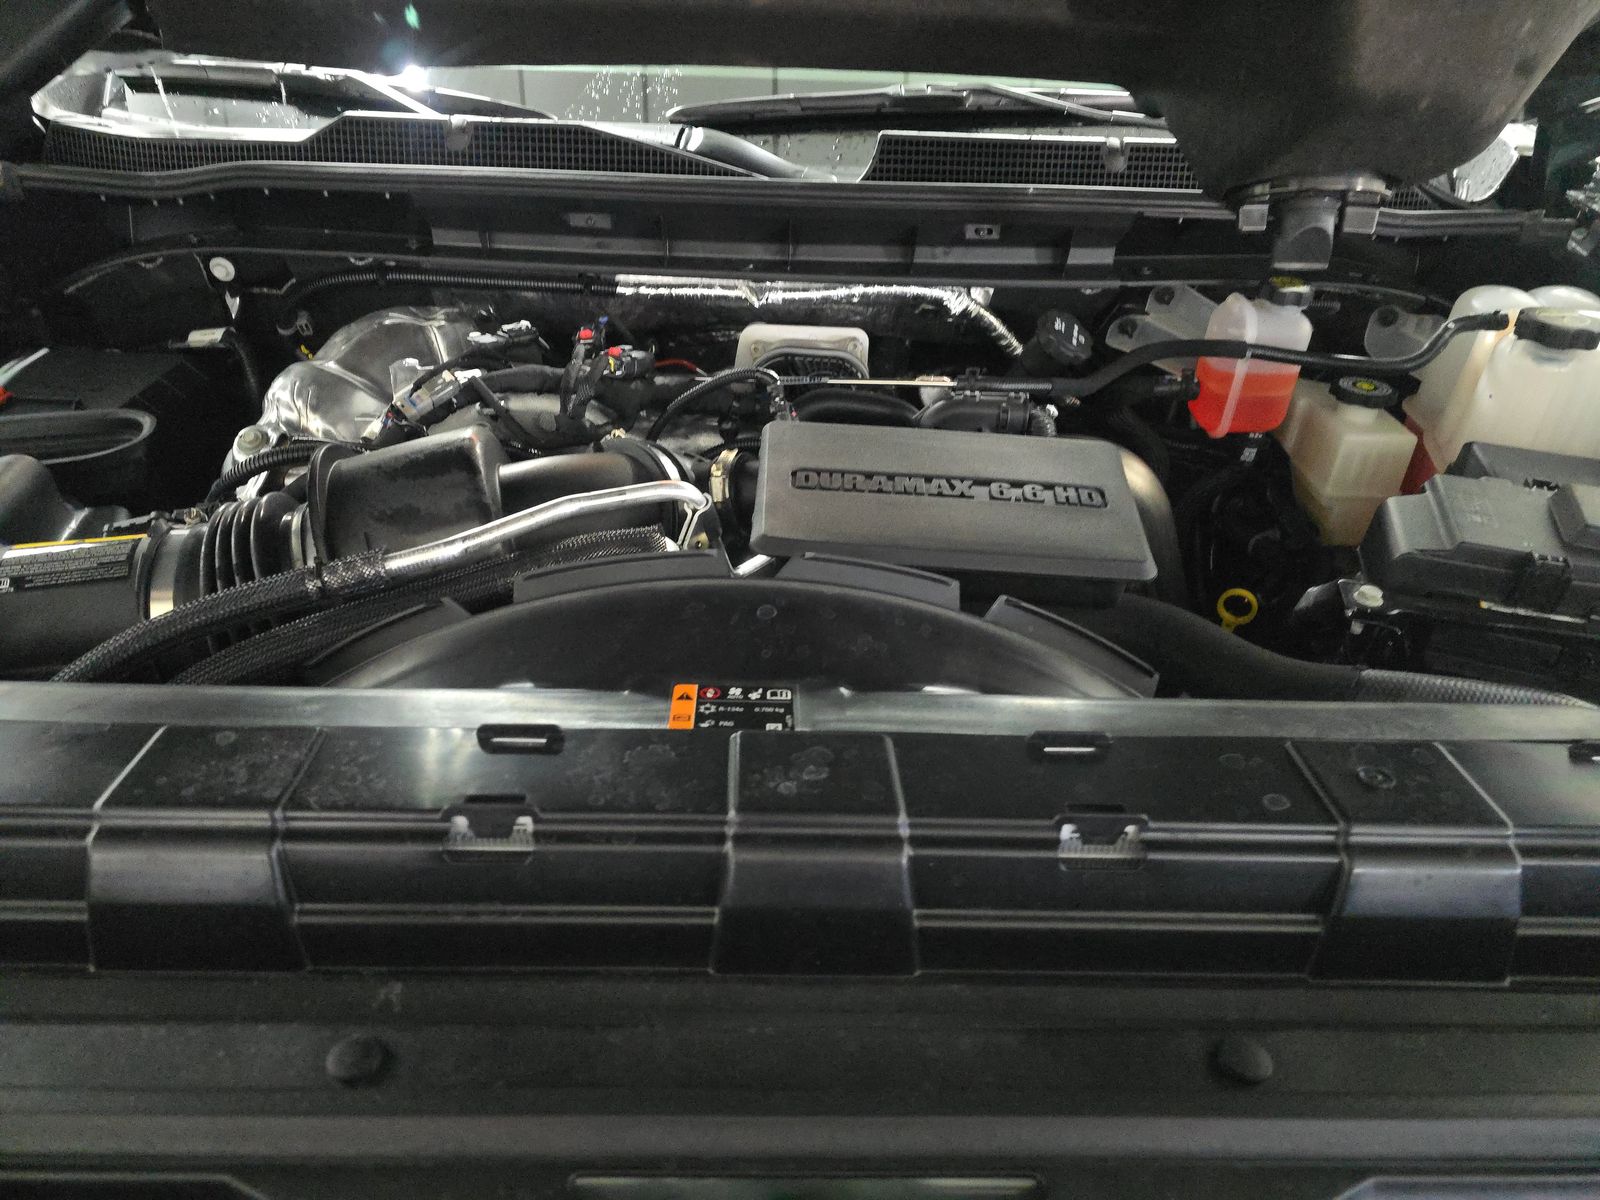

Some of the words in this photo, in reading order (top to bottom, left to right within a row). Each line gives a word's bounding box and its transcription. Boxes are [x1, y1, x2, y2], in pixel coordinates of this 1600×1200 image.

[795, 470, 975, 499] DURAMAX
[989, 482, 1046, 504] 6.6
[1054, 486, 1104, 508] HD
